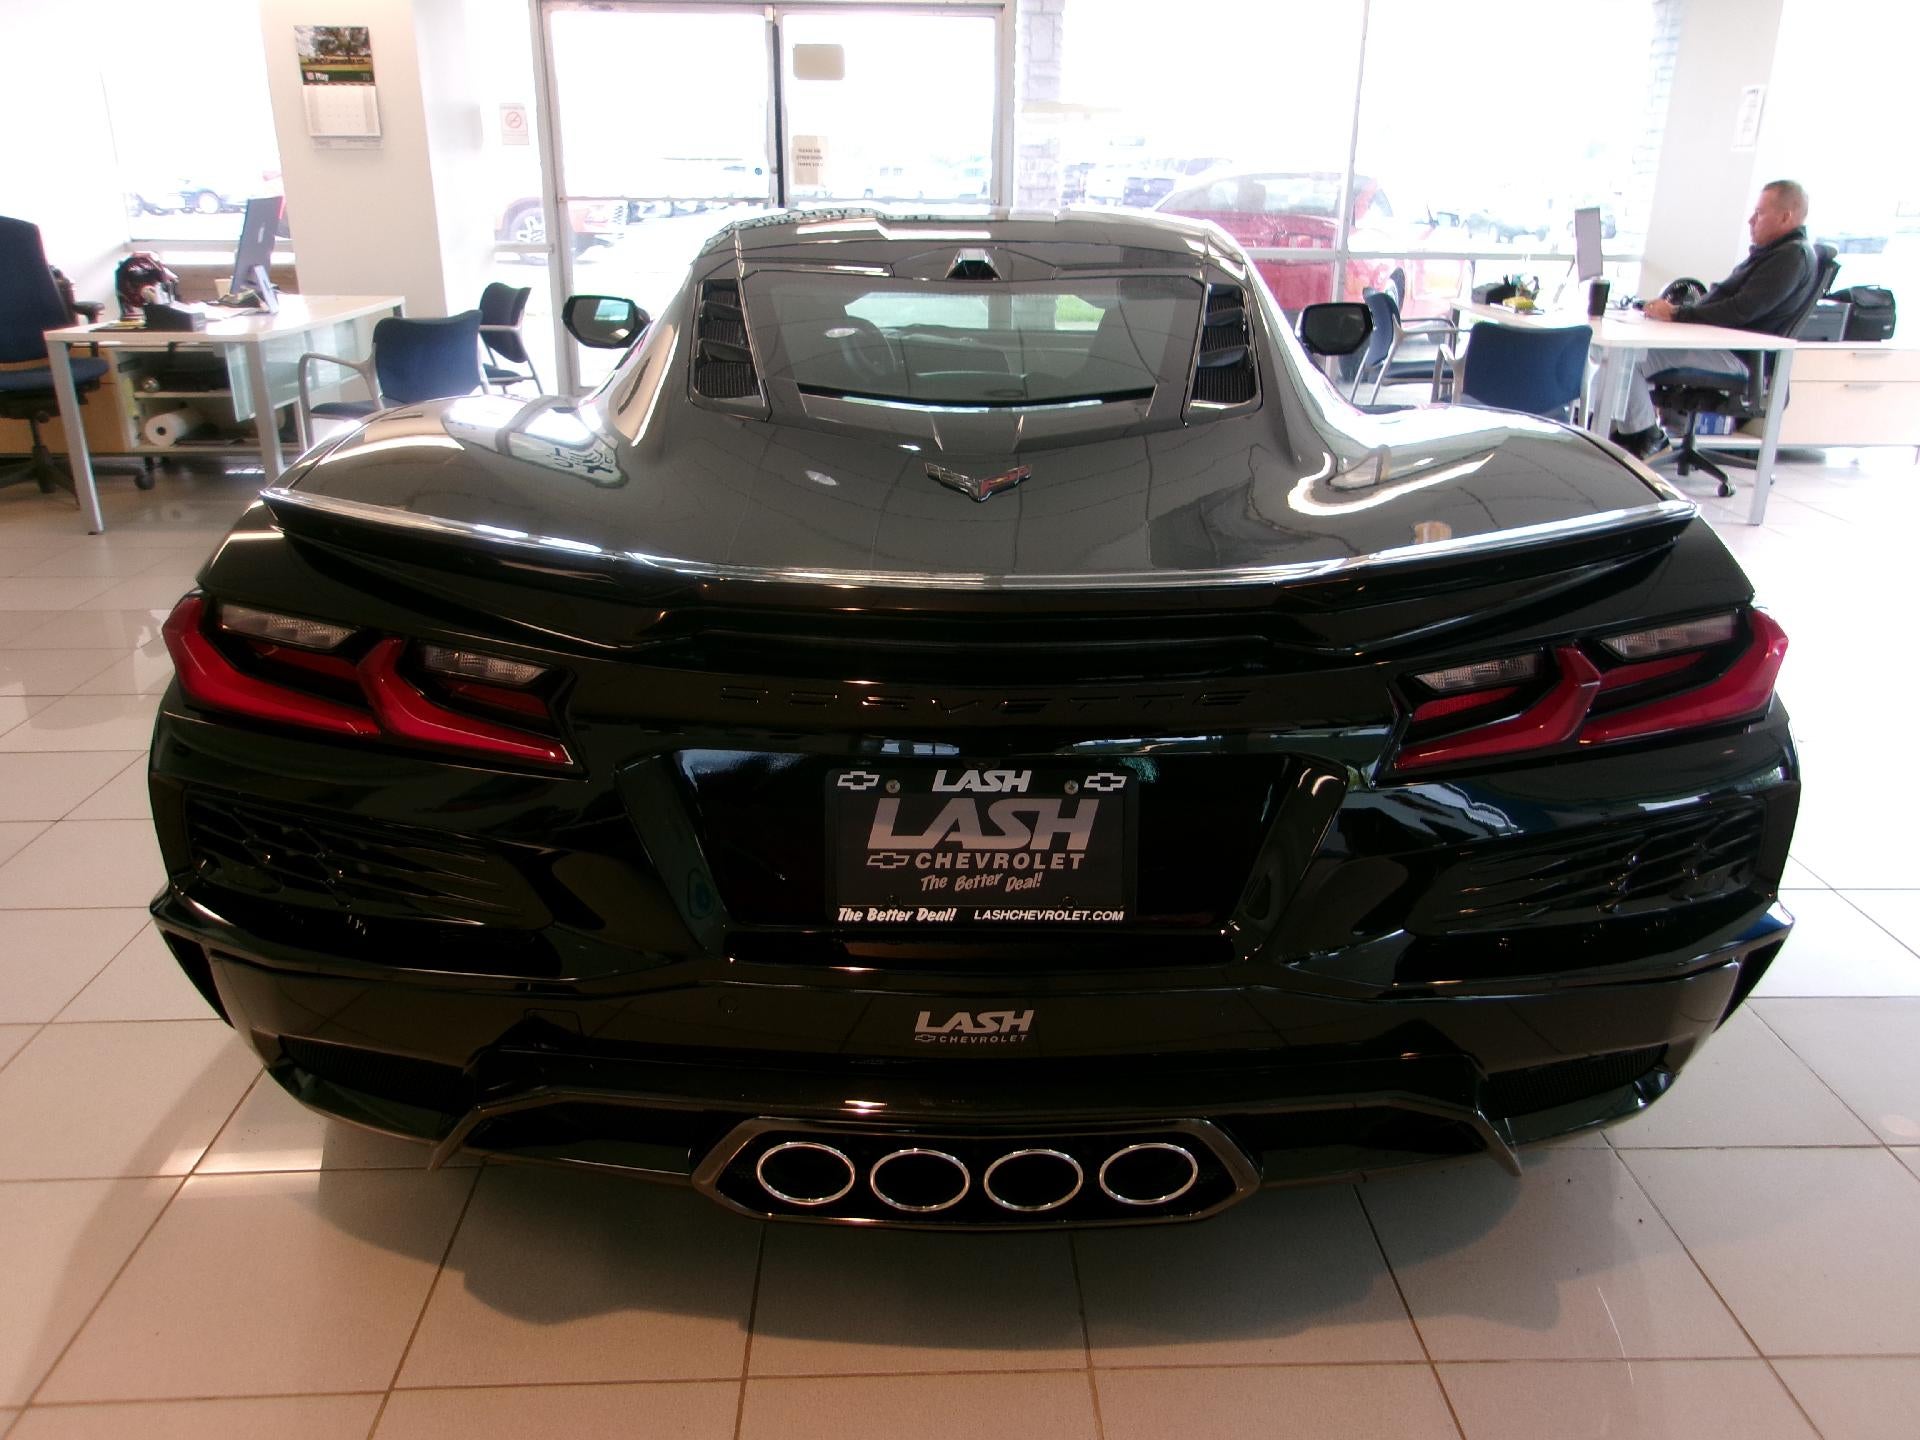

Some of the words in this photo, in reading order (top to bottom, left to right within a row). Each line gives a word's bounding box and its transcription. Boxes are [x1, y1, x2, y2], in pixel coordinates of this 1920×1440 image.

[932, 769, 1032, 792] LASH
[867, 797, 1101, 850] LASH
[914, 852, 1085, 870] CHEVROLET
[920, 875, 948, 892] The
[954, 873, 1003, 892] Better
[1005, 872, 1043, 892] Deal!
[837, 907, 864, 922] The
[866, 907, 914, 922] Better
[916, 907, 957, 922] Deal!
[974, 909, 1125, 921] LASHCHEVROLET.COM
[914, 1009, 1035, 1034] LASH
[939, 1034, 1028, 1044] CHEVROLET
